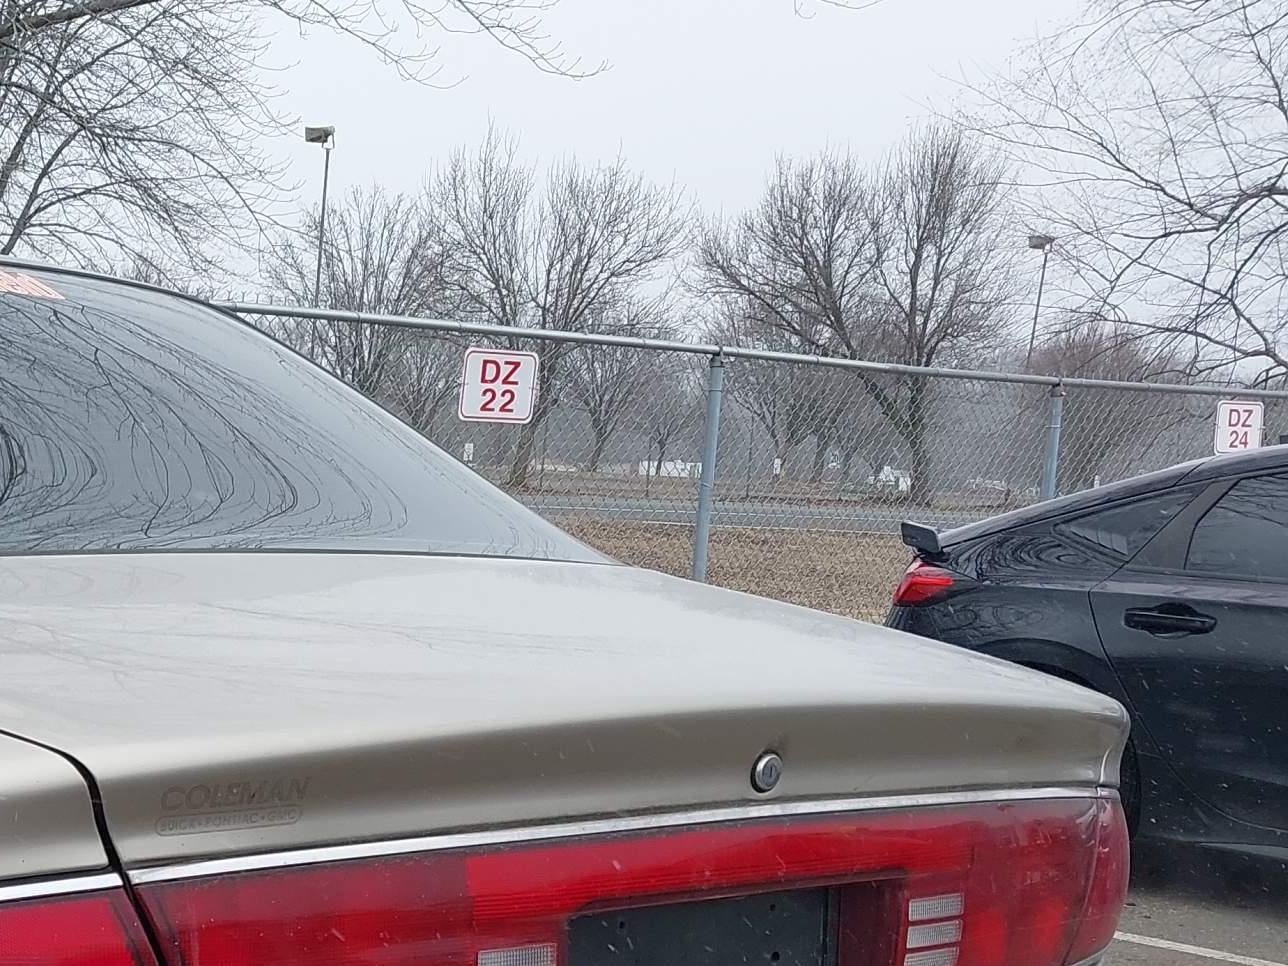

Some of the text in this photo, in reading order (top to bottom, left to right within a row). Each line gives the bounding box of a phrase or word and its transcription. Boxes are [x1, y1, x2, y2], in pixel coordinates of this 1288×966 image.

[480, 359, 521, 385] DZ
[479, 388, 515, 413] 22
[1228, 408, 1253, 428] DZ
[1229, 430, 1249, 448] 24
[161, 777, 312, 811] COLEMAN
